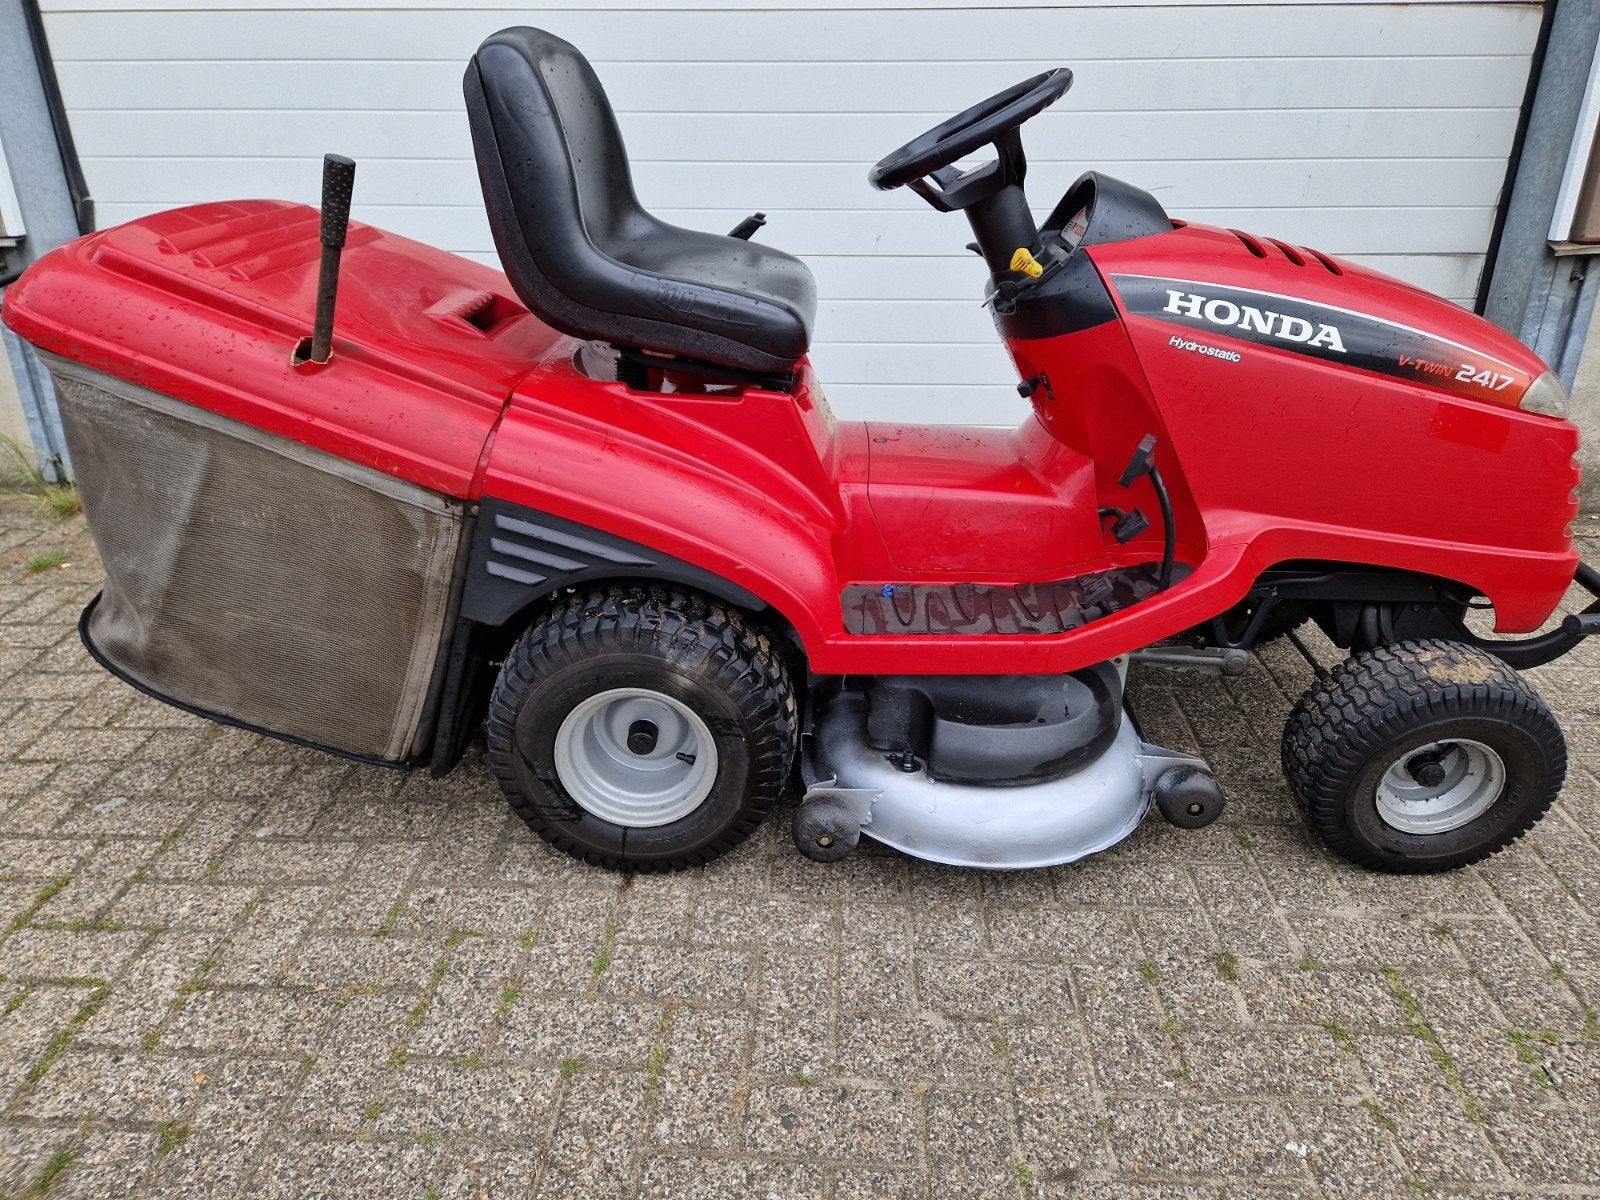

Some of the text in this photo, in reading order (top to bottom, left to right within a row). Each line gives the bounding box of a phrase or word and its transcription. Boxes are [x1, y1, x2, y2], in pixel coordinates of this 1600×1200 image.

[1162, 289, 1347, 353] HONDA
[1168, 336, 1241, 363] Hydrostatic
[1398, 354, 1514, 391] V-TWIN 2417
